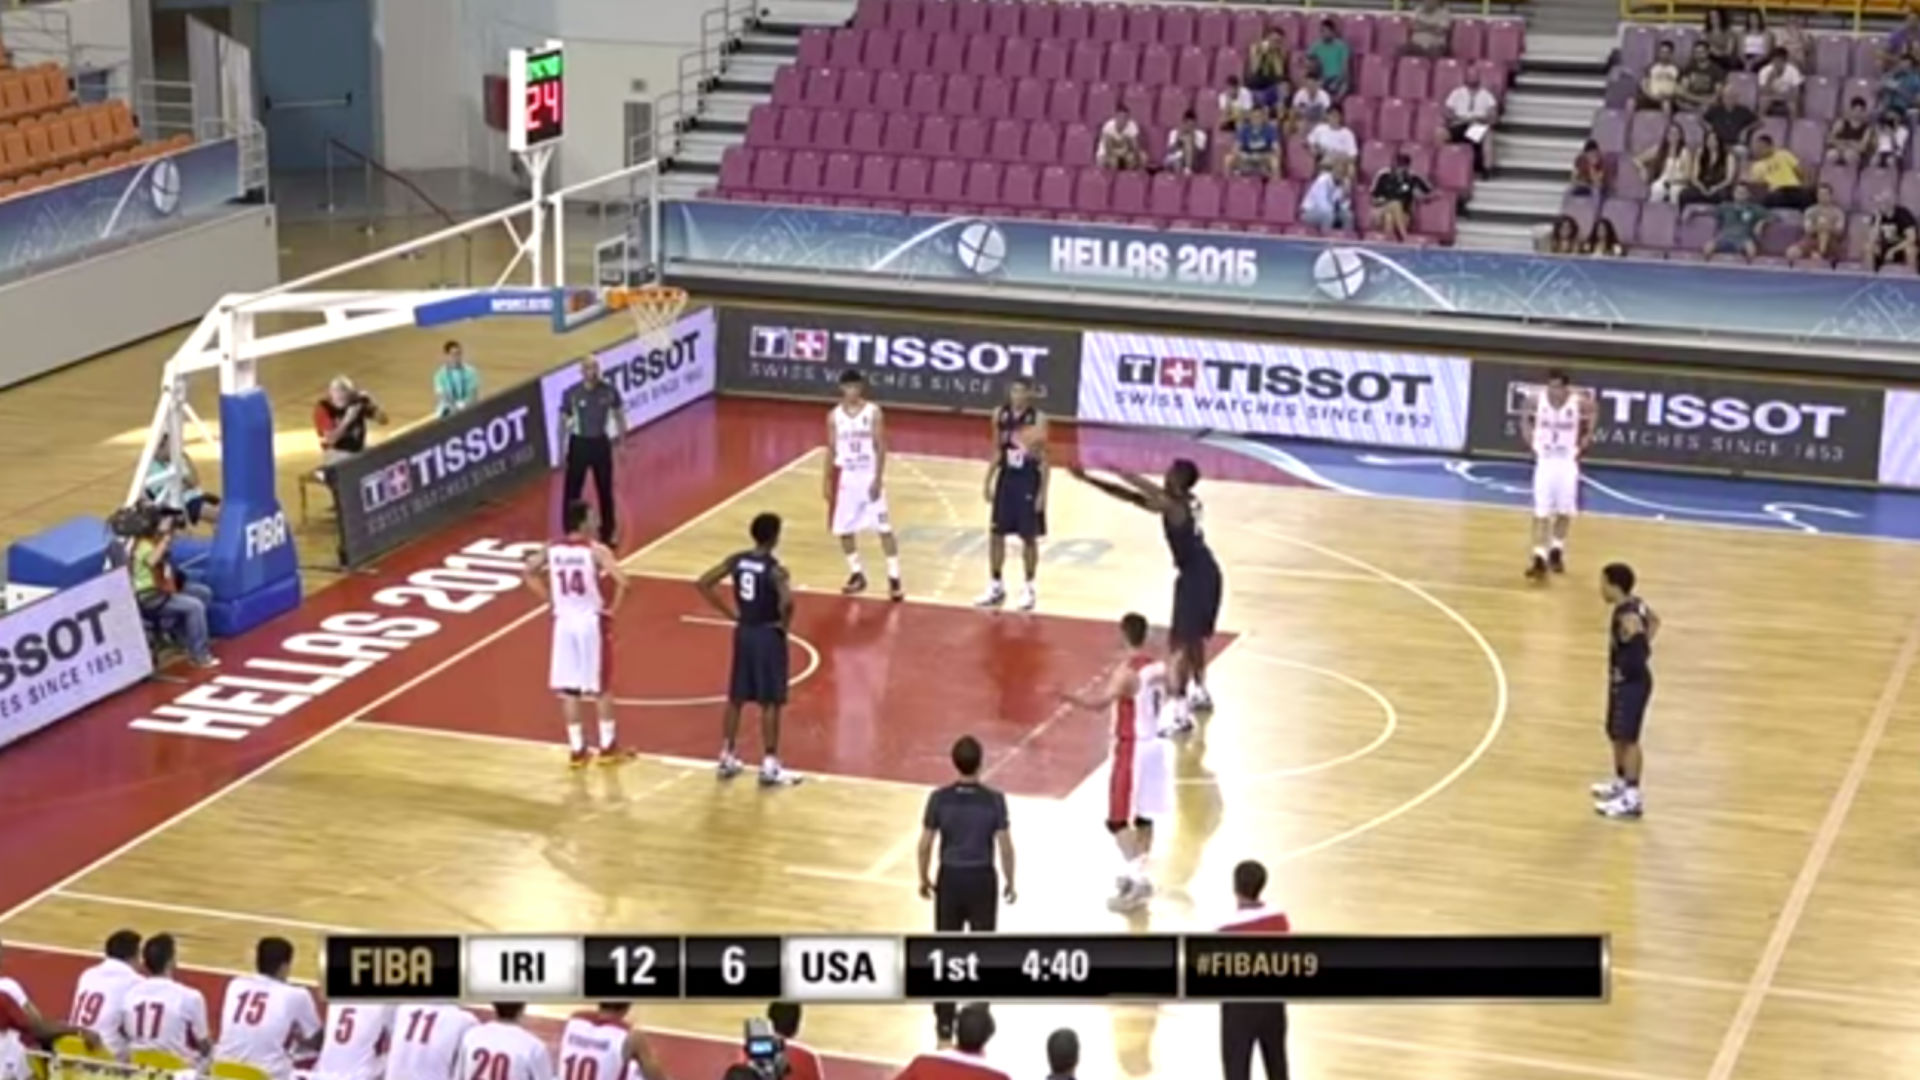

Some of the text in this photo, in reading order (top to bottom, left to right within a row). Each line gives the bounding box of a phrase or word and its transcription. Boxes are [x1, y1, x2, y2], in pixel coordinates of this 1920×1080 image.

[526, 82, 559, 131] 24
[1050, 236, 1258, 287] HELLAS 2015
[833, 331, 1049, 377] TISSOT
[1204, 359, 1433, 406] TISSOT
[1115, 391, 1184, 410] SWISS
[1195, 396, 1297, 418] WATCHES
[1306, 406, 1374, 425] SINCE
[1602, 389, 1846, 438] TISSOT
[410, 406, 529, 487] TISSOT
[1712, 437, 1782, 456] SINCE
[245, 511, 287, 559] FIBA
[557, 568, 586, 597] 14
[740, 572, 756, 601] 9
[128, 538, 550, 740] HELLAS 2015
[28, 666, 81, 706] SINCE
[74, 991, 105, 1027] 19
[133, 1002, 165, 1040] 17
[233, 990, 269, 1025] 15
[335, 1008, 356, 1044] 5
[405, 1010, 437, 1044] 11
[471, 1047, 511, 1080] 20
[564, 1053, 599, 1080] 10
